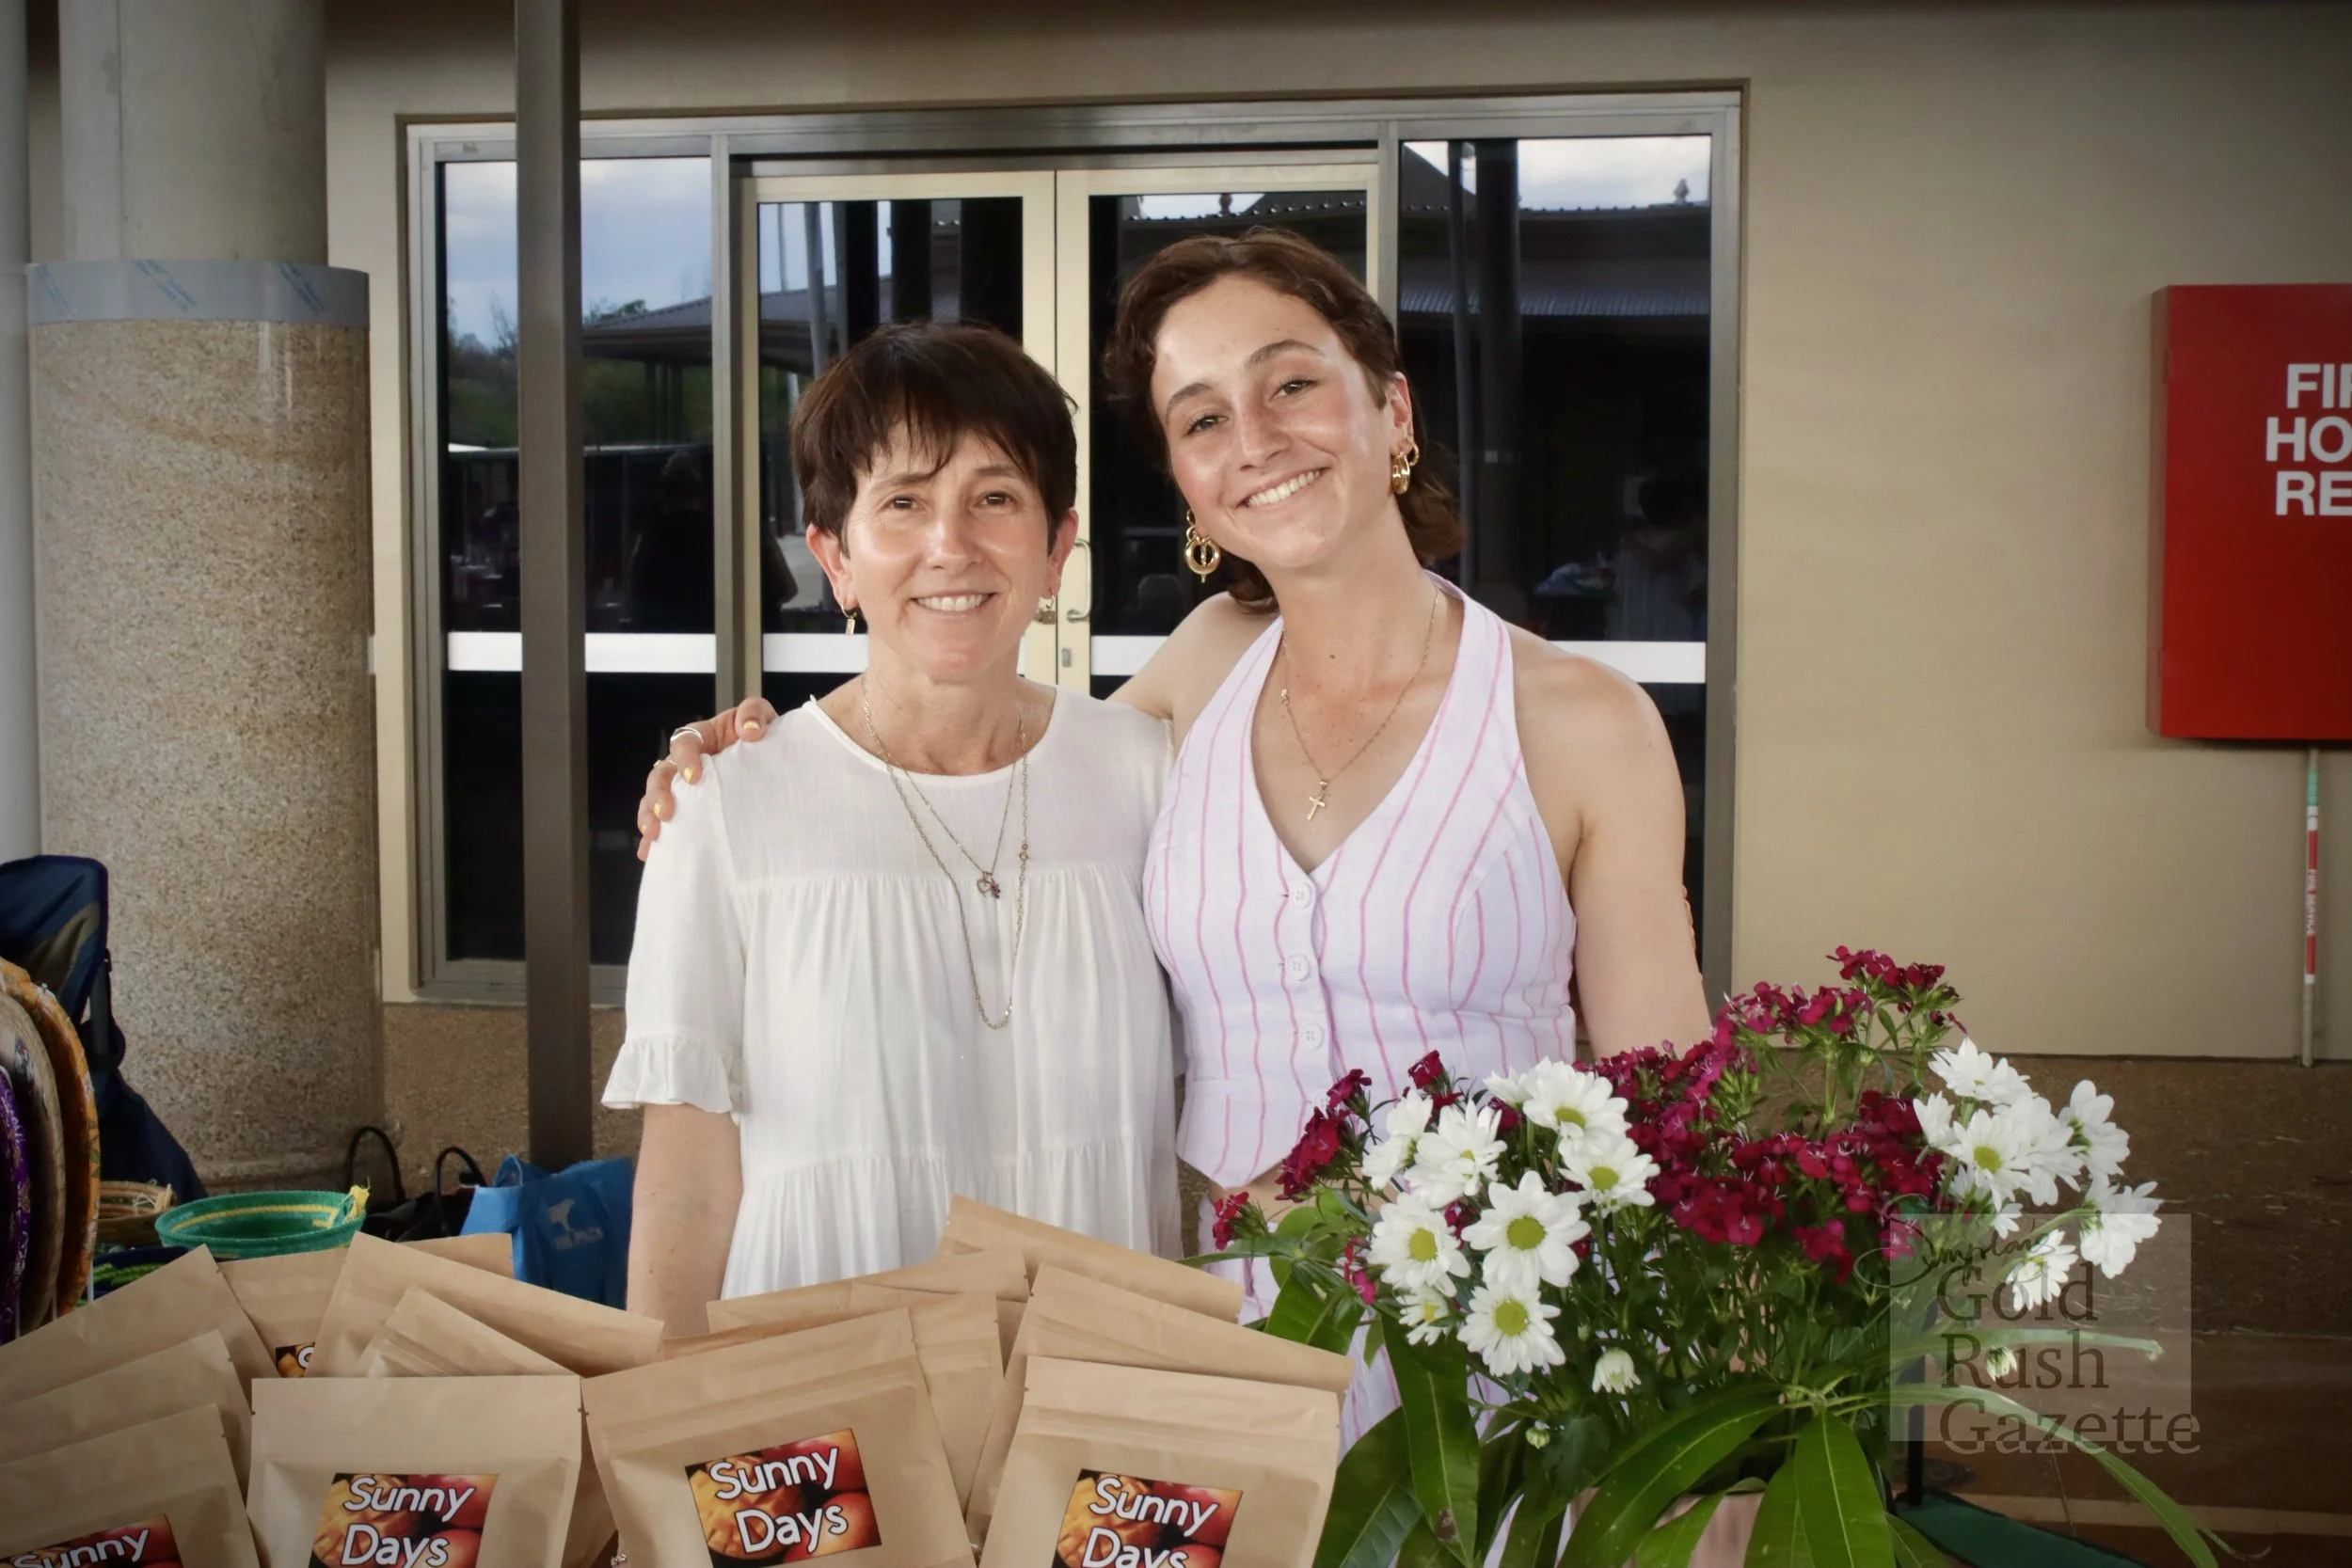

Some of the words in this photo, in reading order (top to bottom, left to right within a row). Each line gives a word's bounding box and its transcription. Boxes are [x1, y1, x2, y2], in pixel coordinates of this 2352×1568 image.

[709, 1447, 839, 1500] Sunny
[342, 1476, 477, 1523] Sunny
[1088, 1476, 1220, 1538] Sunny
[341, 1522, 450, 1568] Days
[734, 1505, 849, 1554] Days
